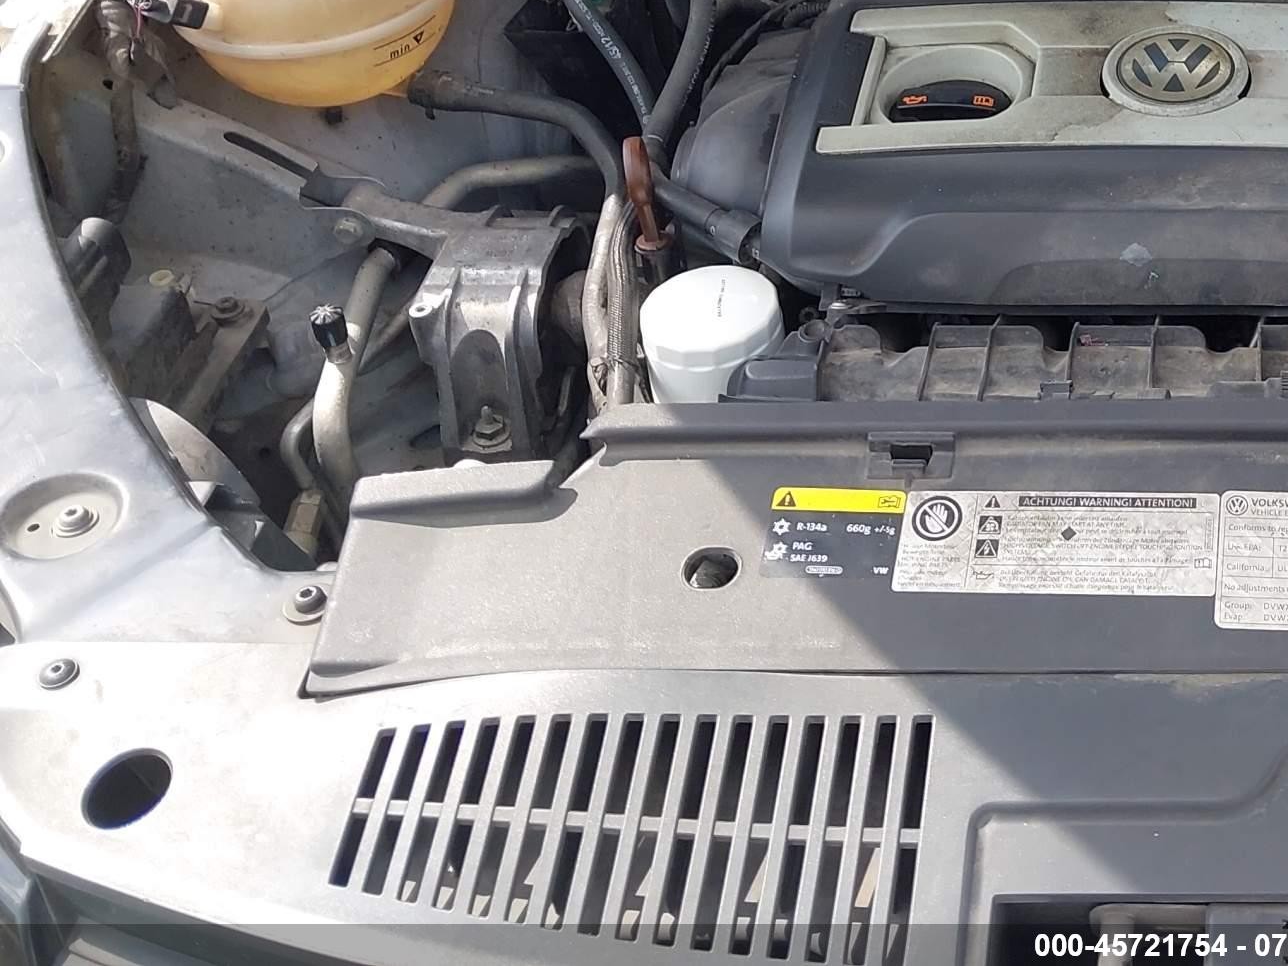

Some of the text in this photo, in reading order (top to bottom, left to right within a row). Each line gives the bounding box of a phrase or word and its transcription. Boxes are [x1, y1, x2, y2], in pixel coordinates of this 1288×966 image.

[389, 43, 411, 59] min
[1022, 497, 1193, 508] ACHTUNG! WARNING! ATTENTION!
[1250, 509, 1283, 517] VEHICLE
[796, 522, 828, 532] R-134a
[846, 523, 871, 535] 660g
[1228, 523, 1266, 533] Conforms
[792, 541, 814, 551] PAG
[789, 553, 807, 563] SAE
[872, 566, 889, 575] VW
[1237, 583, 1285, 593] adjustments
